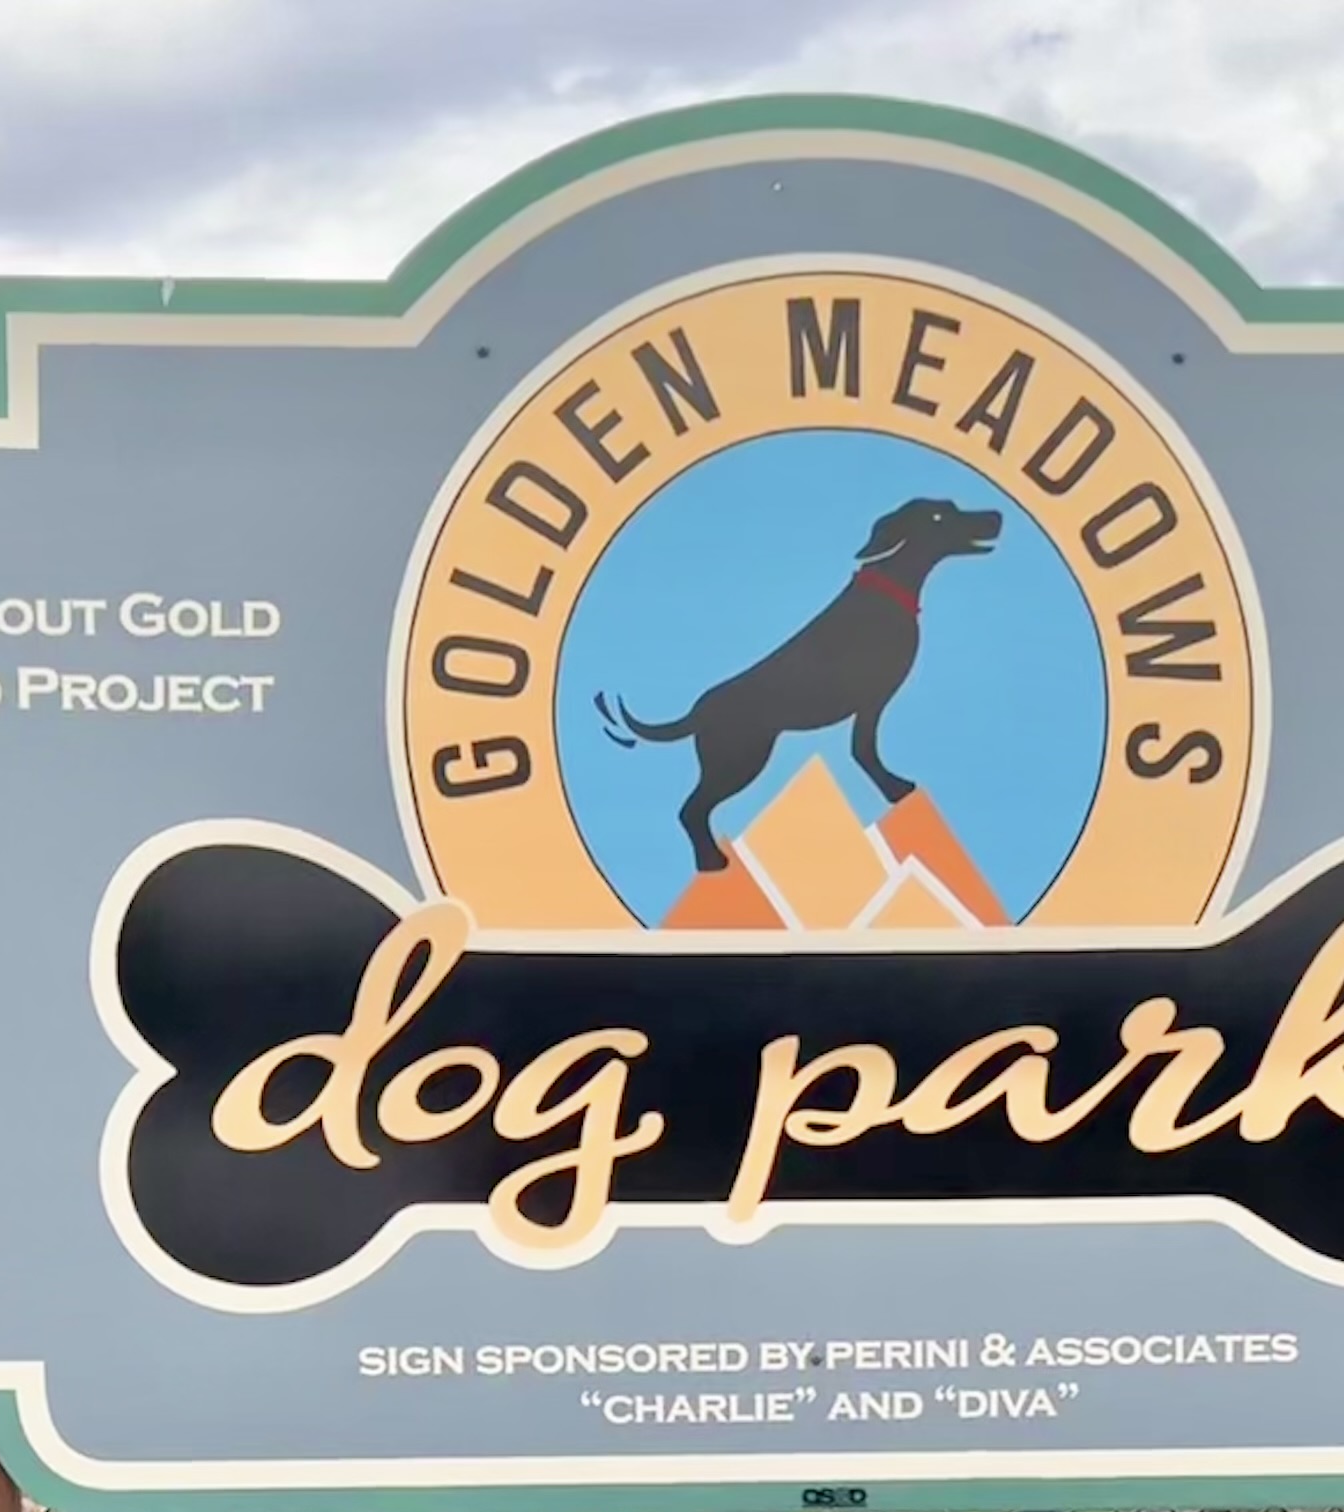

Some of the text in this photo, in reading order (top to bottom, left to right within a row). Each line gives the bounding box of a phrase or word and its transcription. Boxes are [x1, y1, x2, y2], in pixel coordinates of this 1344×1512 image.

[431, 297, 1224, 798] GOLDEN MEADOWS
[119, 592, 280, 637] GOLD
[17, 666, 274, 712] PROJECT
[211, 899, 665, 1250] dog
[359, 1333, 1298, 1376] SIGN SPONSORED BY PERINI & ASSOCIATES
[581, 1382, 1079, 1424] “CHARLIE” AND “DIVA”
